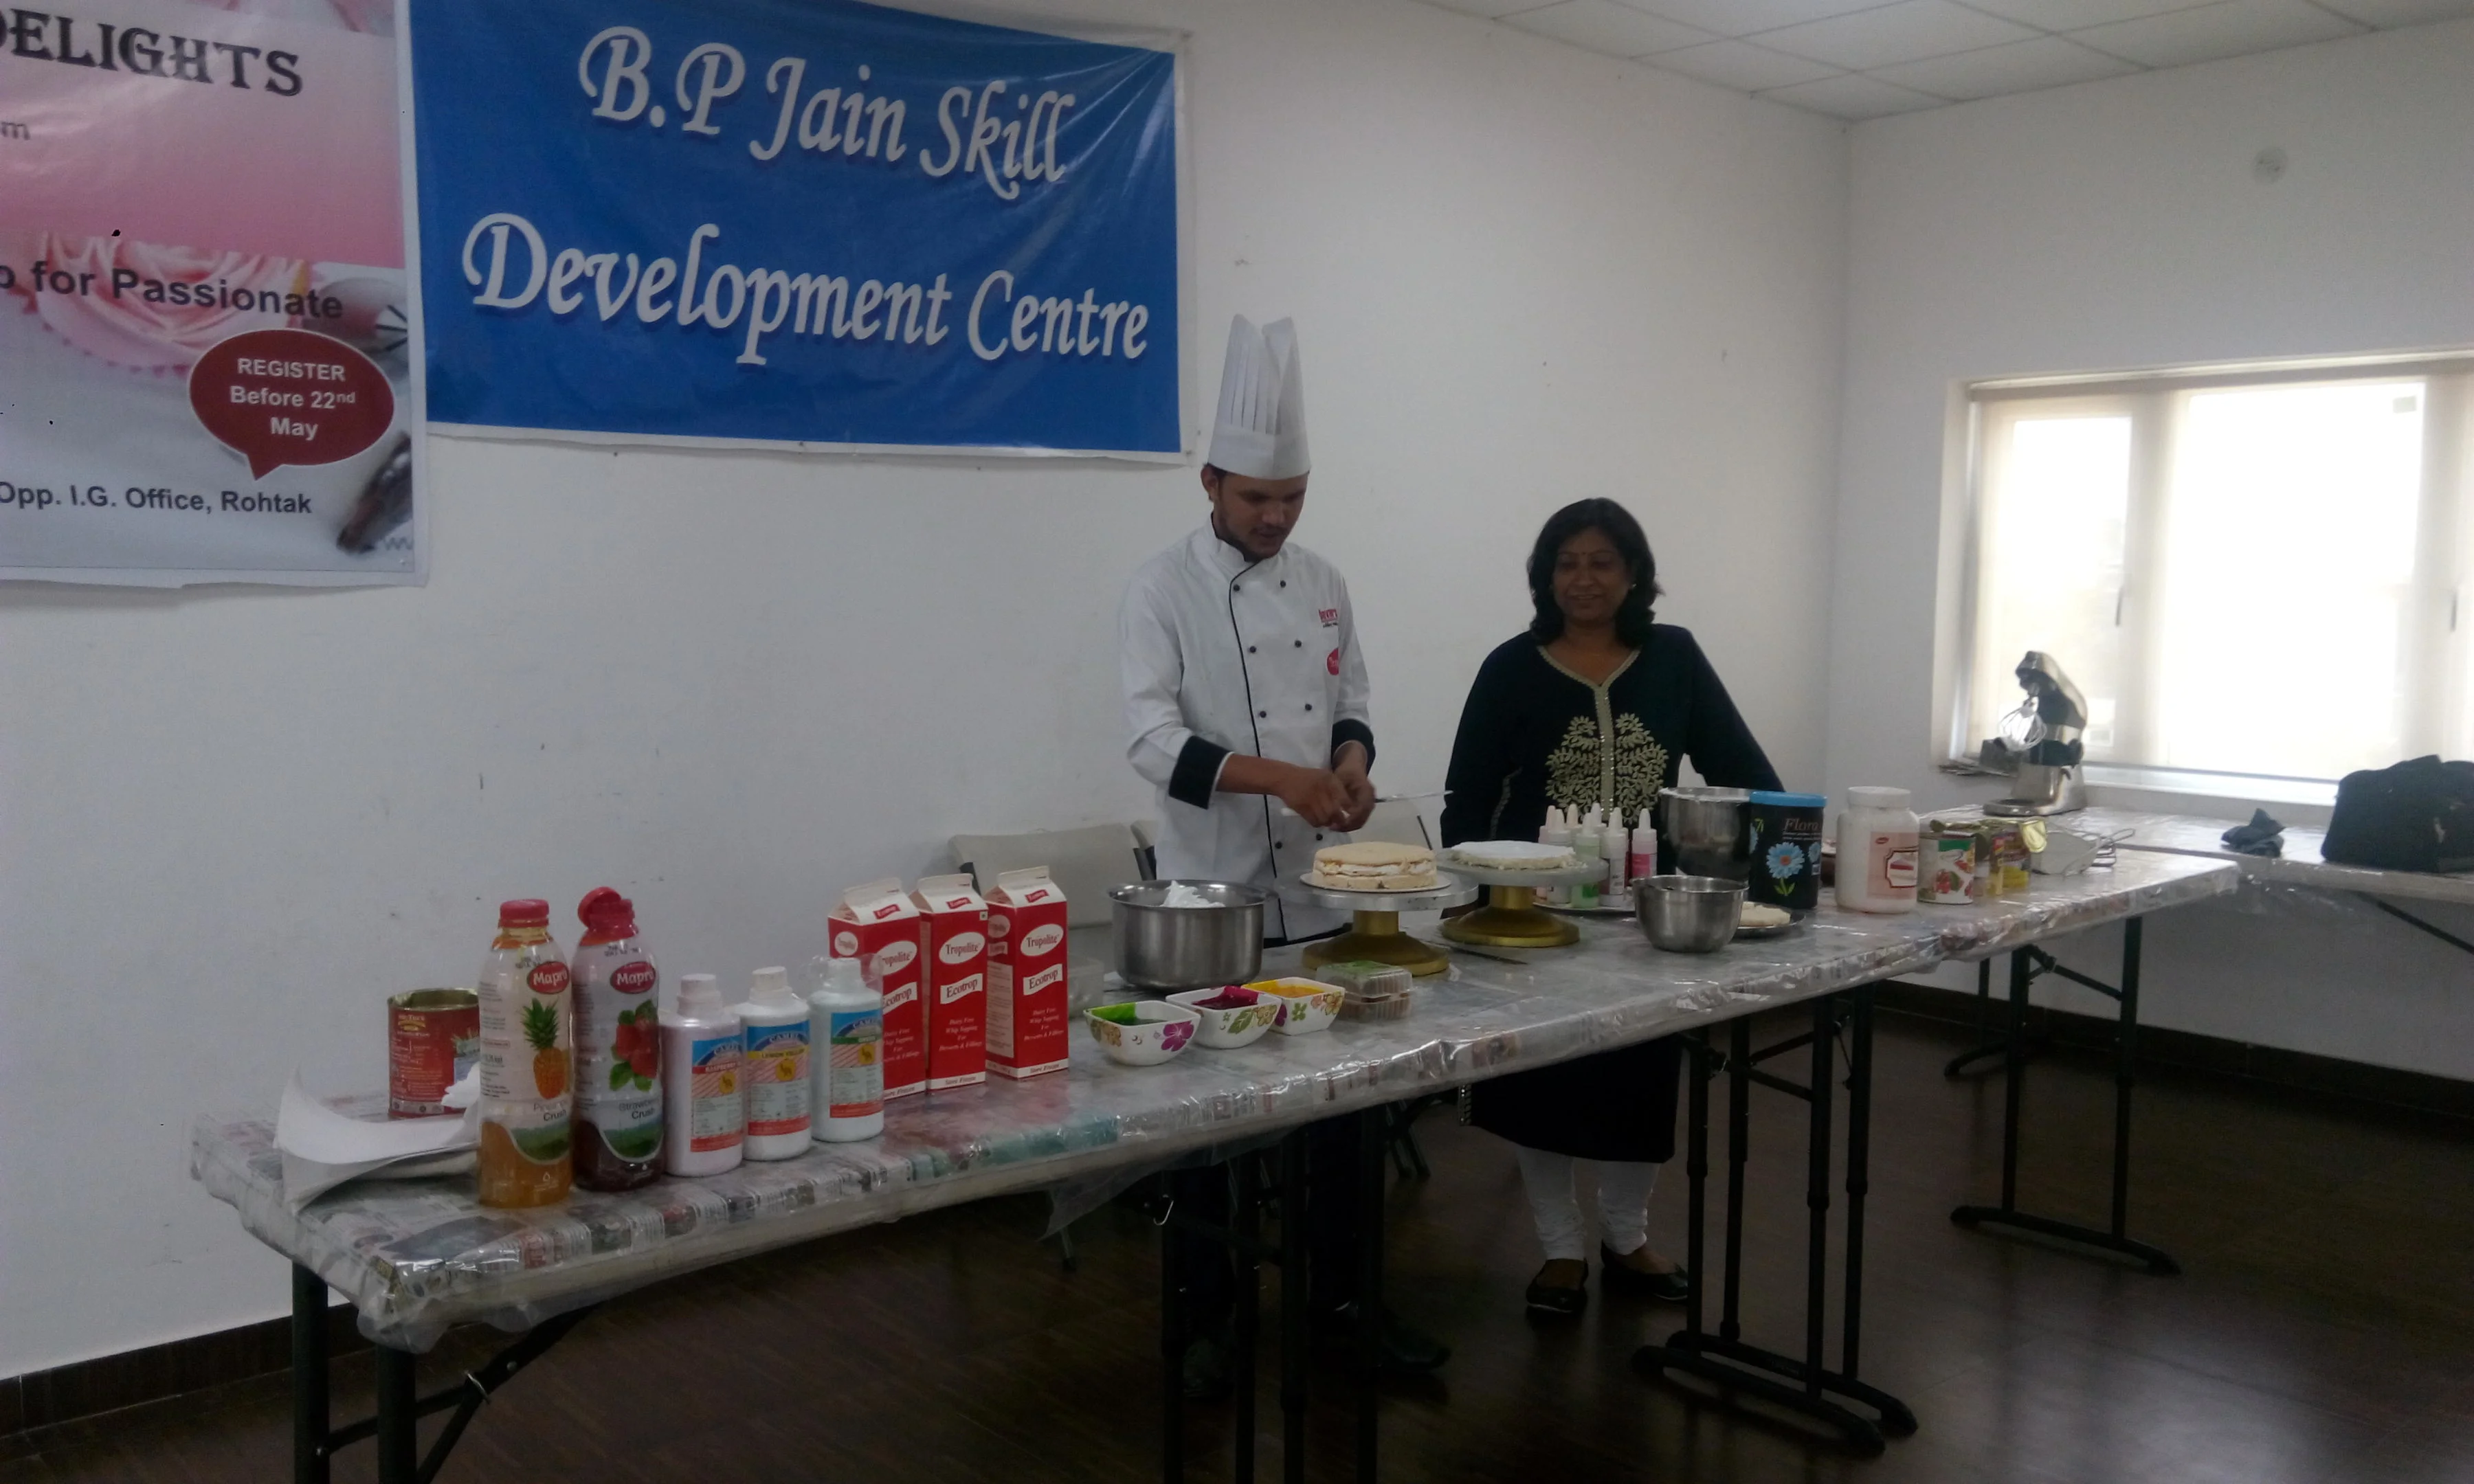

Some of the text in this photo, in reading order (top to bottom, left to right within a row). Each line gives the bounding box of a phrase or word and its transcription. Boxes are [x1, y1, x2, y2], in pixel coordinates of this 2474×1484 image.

[0, 5, 303, 97] ELIGHTS
[579, 25, 1076, 201] B.P Jain Skill
[30, 260, 96, 296] for
[112, 268, 344, 318] Passionate
[462, 213, 1150, 366] Development Centre
[237, 358, 346, 382] REGISTER
[230, 385, 304, 407] Before
[270, 416, 318, 441] May
[0, 482, 312, 515] Opp. I.G. Office, Rohtak
[1781, 818, 1820, 833] Flora
